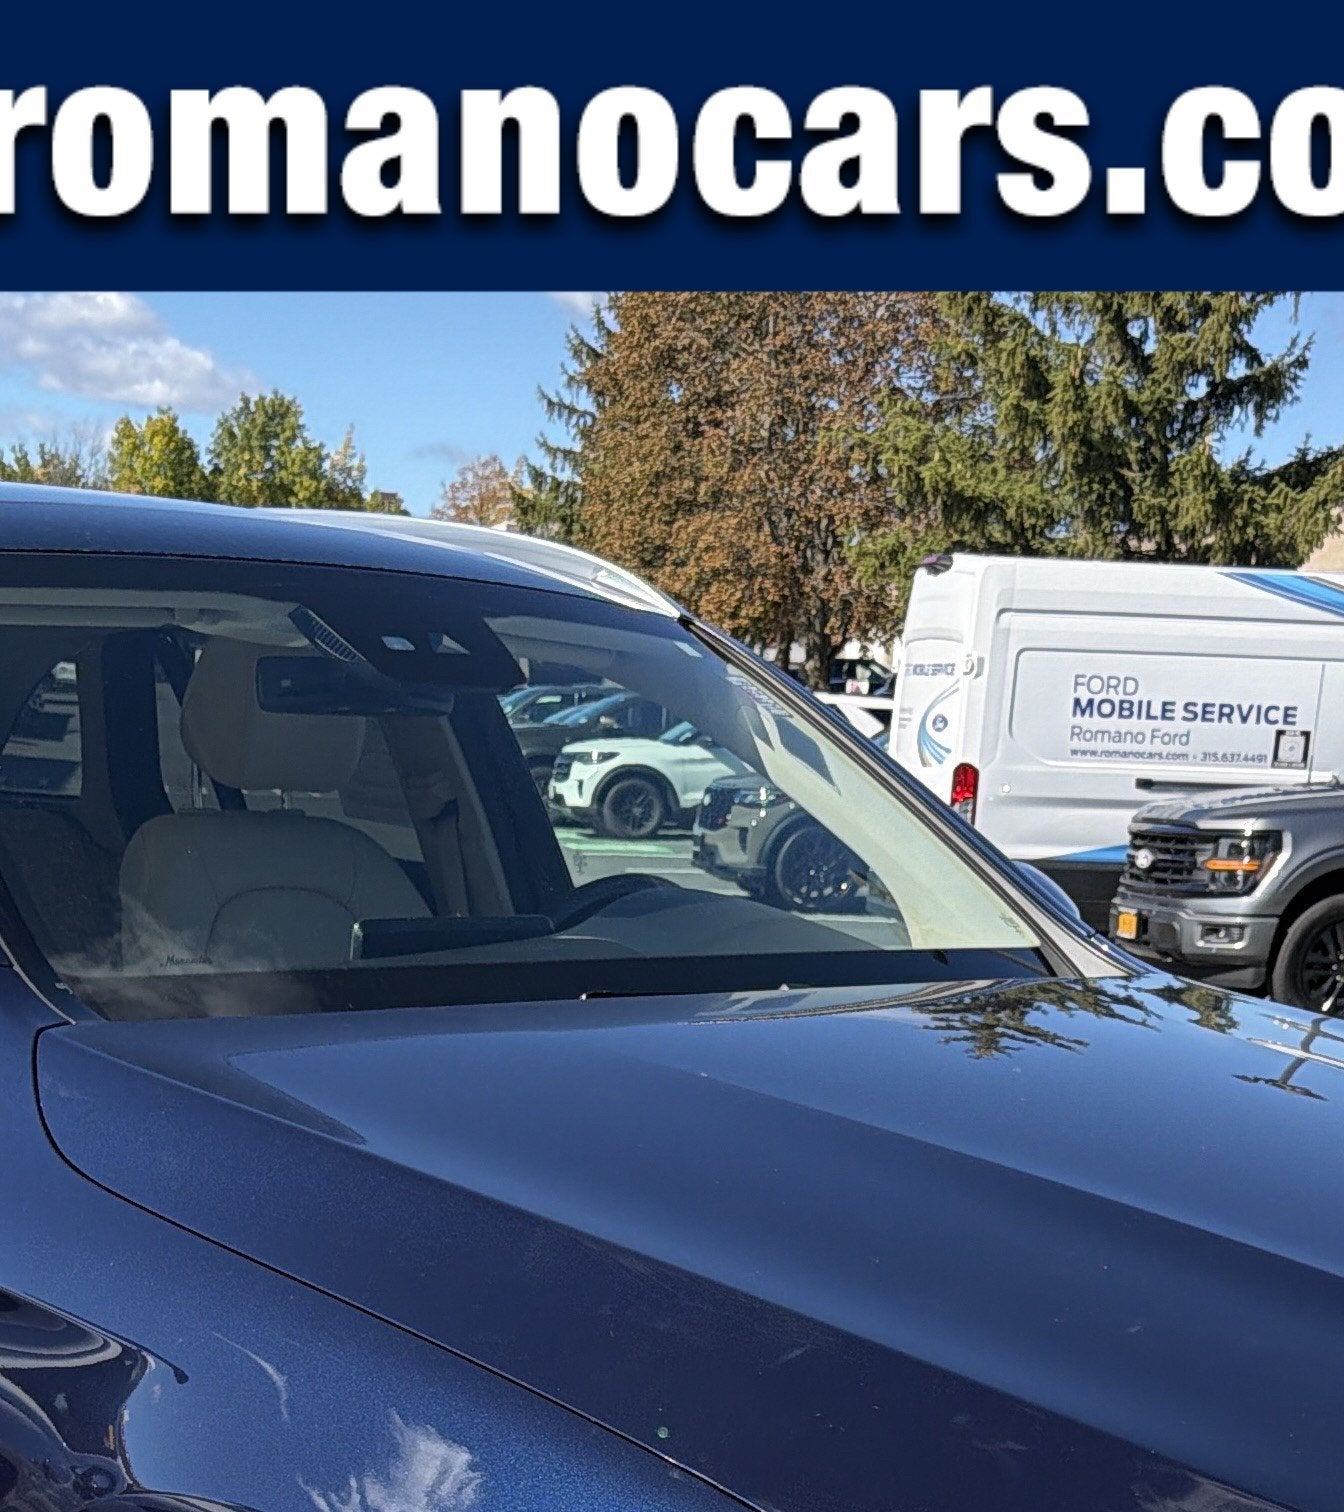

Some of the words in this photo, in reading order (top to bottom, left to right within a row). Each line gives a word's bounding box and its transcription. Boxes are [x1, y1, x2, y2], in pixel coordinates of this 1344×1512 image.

[1072, 674, 1139, 696] FORD
[1071, 697, 1176, 721] MOBILE
[1180, 701, 1298, 726] SERVICE
[1069, 725, 1146, 745] Romano
[1149, 728, 1191, 746] Ford
[1069, 748, 1189, 761] www.romanocars.com
[1199, 752, 1268, 763] 315.637.4491
